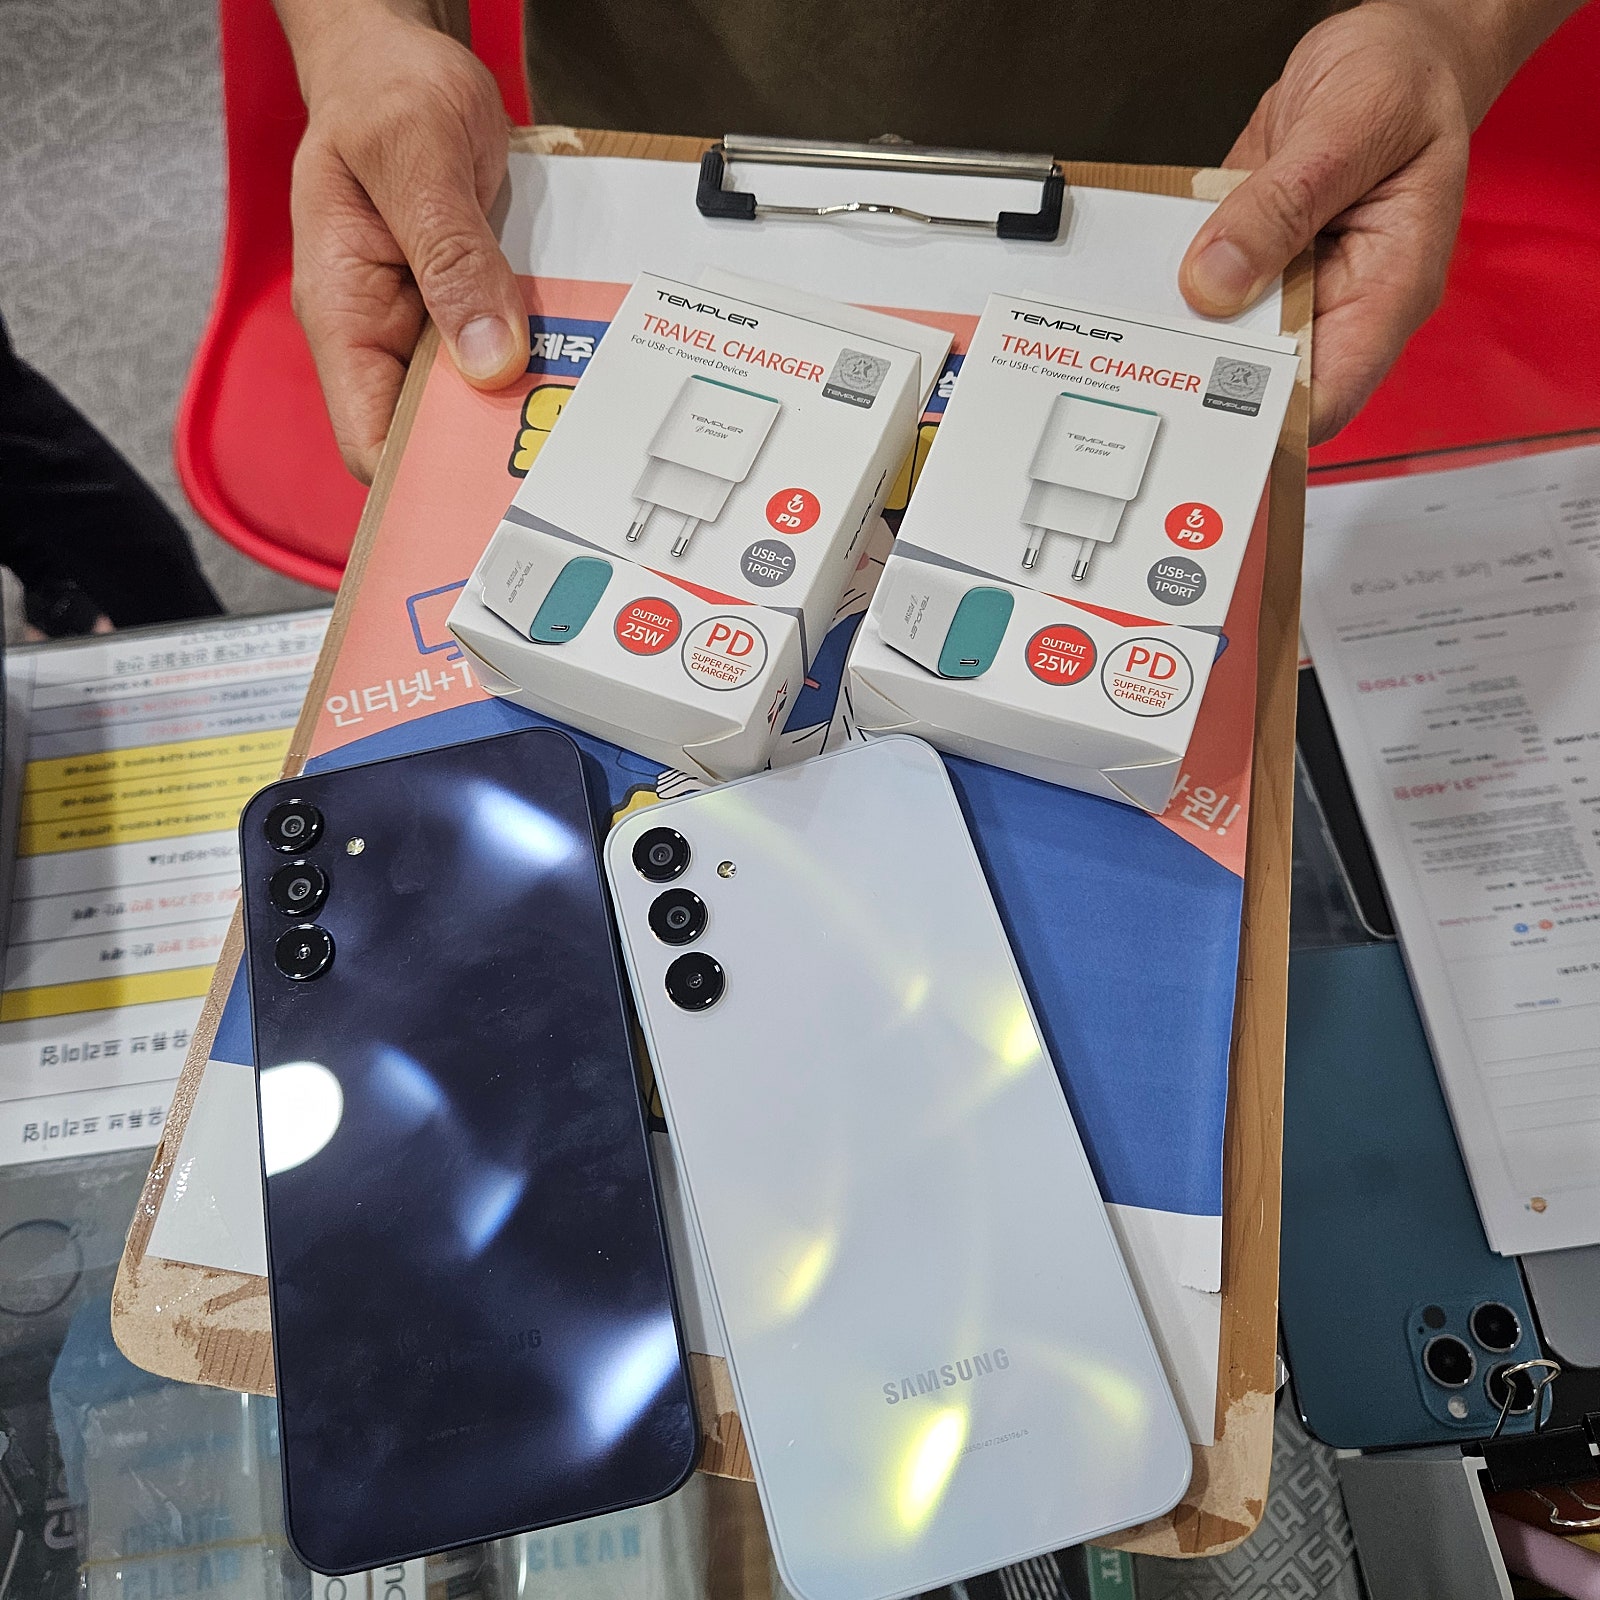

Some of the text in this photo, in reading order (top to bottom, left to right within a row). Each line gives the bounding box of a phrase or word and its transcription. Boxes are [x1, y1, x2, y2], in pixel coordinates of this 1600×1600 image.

[656, 290, 759, 330] TEMPLER
[1010, 310, 1124, 343] TEMPLER
[531, 333, 595, 363] 제주
[630, 335, 749, 378] For USB-C Powered Devices
[642, 313, 826, 384] TRAVEL CHARGER
[991, 356, 1121, 393] For USB-C Powered Devices
[1001, 334, 1202, 393] TRAVEL CHARGER
[827, 388, 871, 405] TEMPLER
[1206, 398, 1257, 412] TEMPLER
[691, 413, 744, 434] TEMPLER
[1067, 432, 1126, 451] TEMPLER
[776, 513, 801, 528] PD
[1177, 529, 1205, 543] PD
[751, 545, 792, 568] USB-C
[746, 561, 784, 581] 1PORT
[1157, 565, 1202, 583] USB-C
[1155, 580, 1196, 599] 1PORT
[631, 607, 674, 629] OUTPUT
[620, 623, 665, 648] 25W
[706, 622, 755, 658] PD
[1041, 636, 1087, 656] OUTPUT
[690, 662, 739, 685] CHARGER!
[691, 652, 747, 678] SUPER FAST
[1034, 652, 1081, 677] 25W
[1125, 645, 1178, 681] PD
[1112, 679, 1174, 701] SUPER FAST
[1113, 687, 1167, 710] CHARGER!
[39, 1038, 122, 1067] 프리미엄
[22, 1115, 100, 1144] 프리미엄
[883, 1347, 1010, 1405] SAMSUNG
